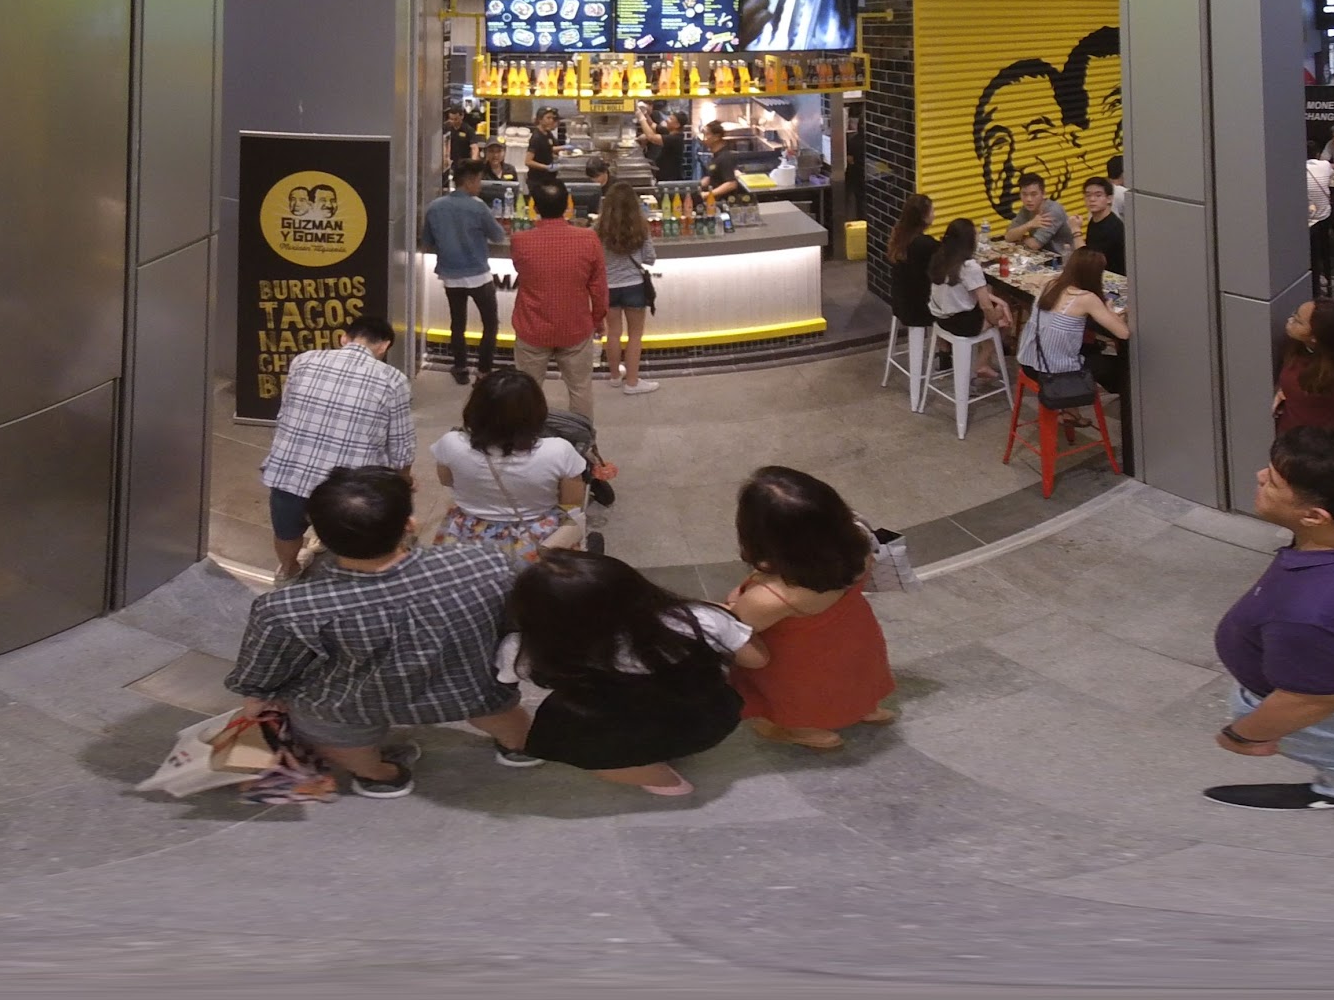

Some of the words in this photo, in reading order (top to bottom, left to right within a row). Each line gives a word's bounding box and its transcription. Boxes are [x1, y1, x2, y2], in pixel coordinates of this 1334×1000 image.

[281, 217, 343, 231] GUZMAN
[280, 231, 290, 242] Y
[293, 230, 345, 244] GOMEZ
[259, 276, 366, 299] BURRITOS
[259, 298, 364, 329] TACOS
[258, 329, 347, 352] NACHO
[258, 353, 295, 373] CH
